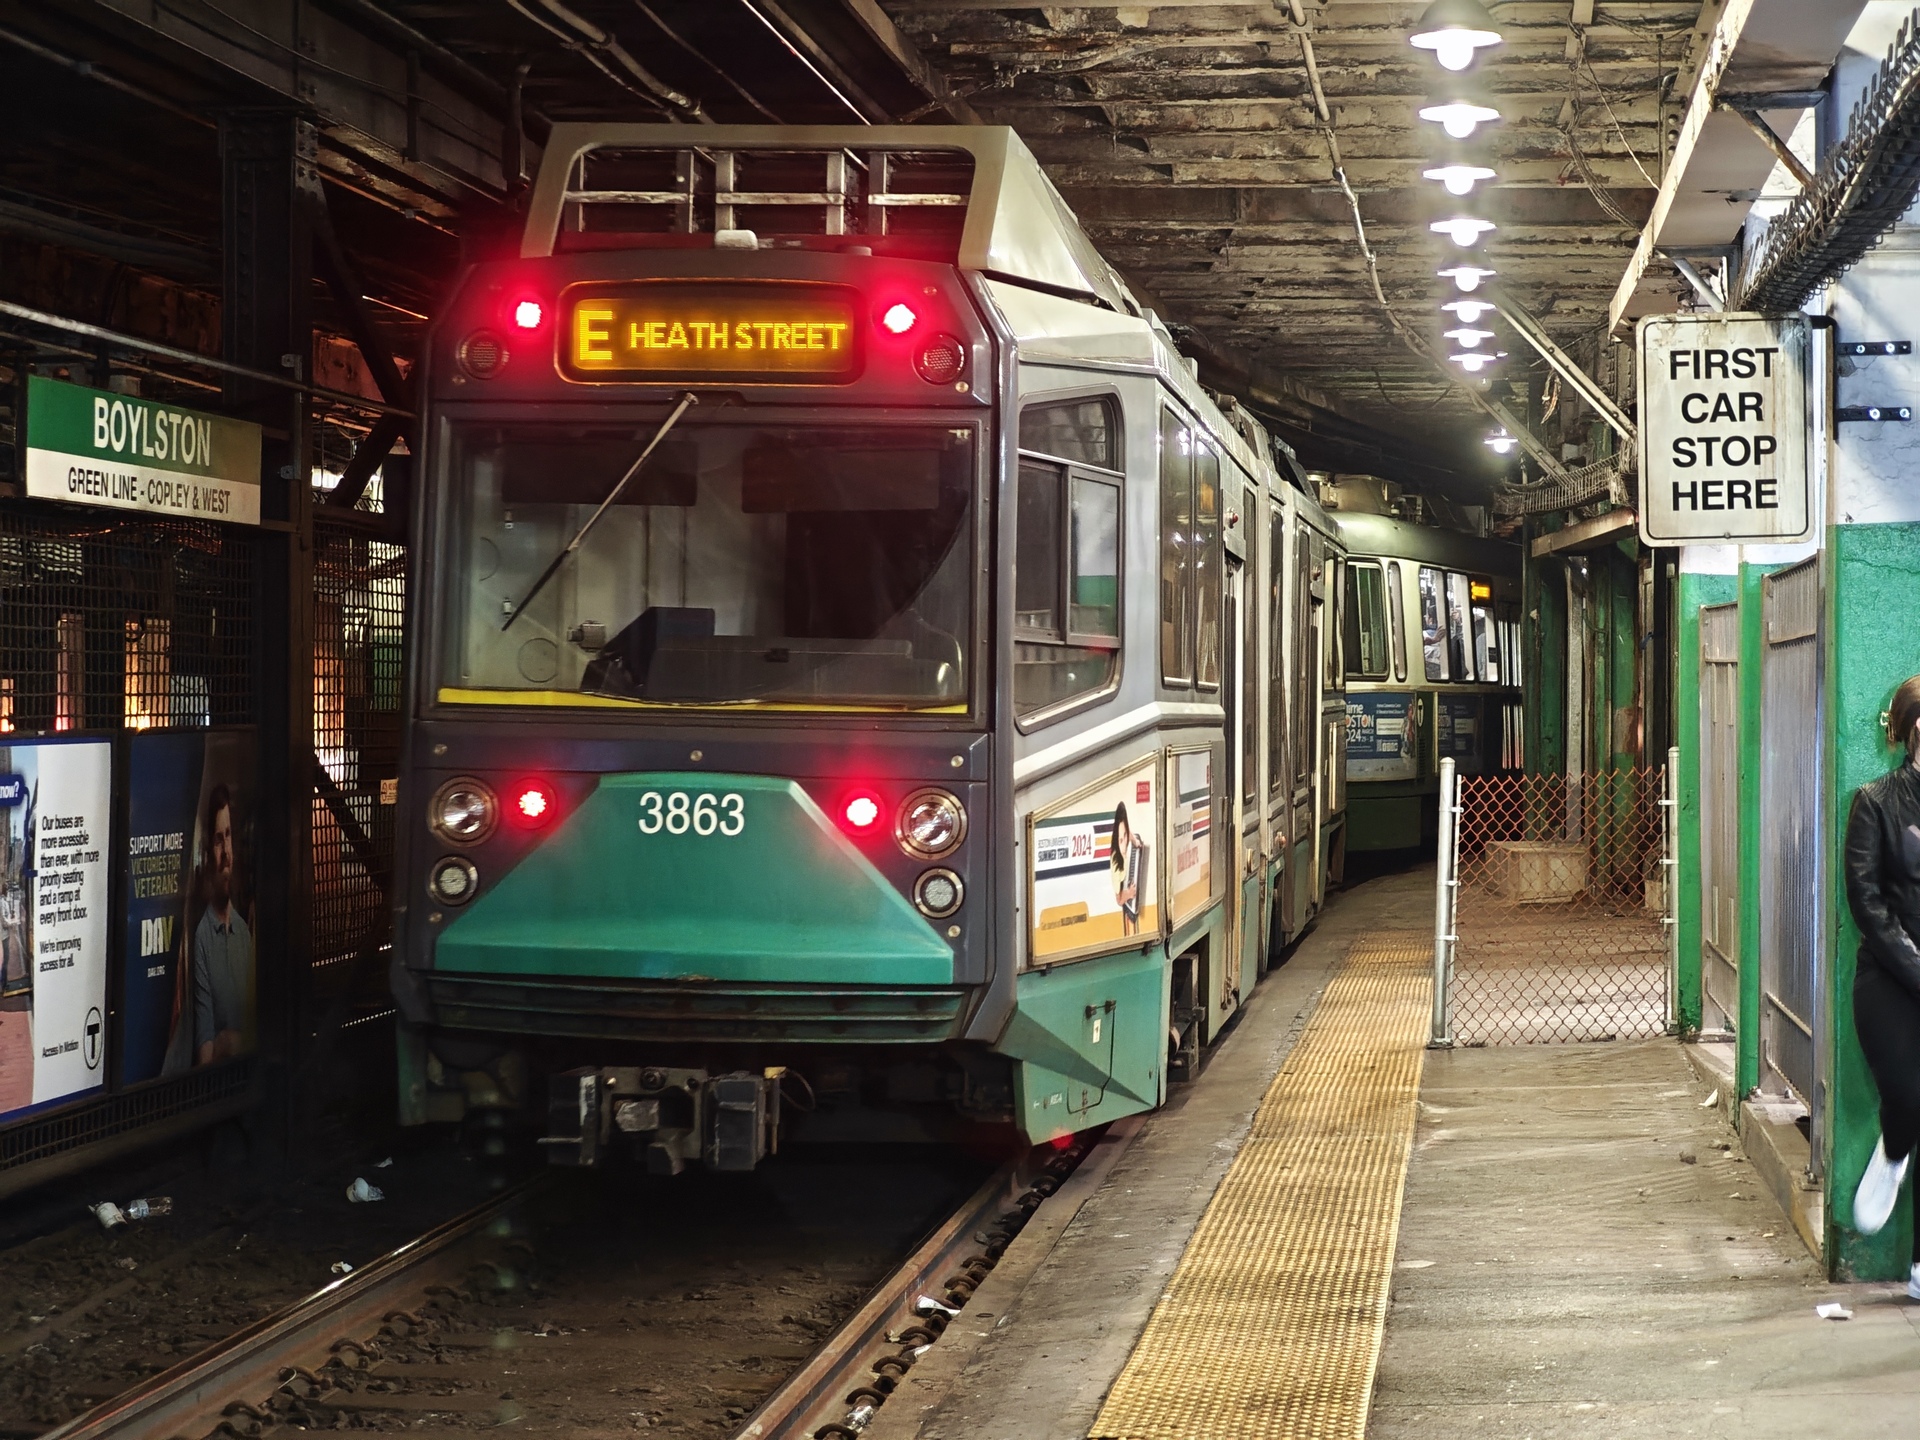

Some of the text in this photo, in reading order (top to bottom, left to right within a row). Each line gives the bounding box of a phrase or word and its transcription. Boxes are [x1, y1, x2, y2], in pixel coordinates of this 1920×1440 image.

[579, 310, 846, 360] E HEATH STREET
[1670, 347, 1779, 380] FIRST
[1681, 391, 1763, 423] CAR
[94, 396, 211, 467] BOYLSTON
[1672, 435, 1777, 468] STOP
[68, 466, 109, 498] GREEN
[112, 473, 137, 502] LINE
[147, 478, 189, 509] COPLEY
[192, 489, 200, 510] &
[202, 490, 231, 514] WEST
[1672, 478, 1779, 511] HERE
[1345, 714, 1375, 728] OSTON
[1346, 728, 1361, 742] 024
[0, 781, 20, 799] now?
[42, 814, 84, 831] Our buses are
[638, 791, 745, 836] 3863
[41, 830, 90, 850] more accessible
[129, 832, 184, 856] SUPPORT MORE
[1072, 834, 1092, 858] 2024
[40, 849, 100, 868] than ever, with more
[131, 853, 182, 876] VICTORIES FOR
[40, 867, 84, 892] priority seating
[134, 873, 179, 899] VETERANS
[40, 888, 81, 906] and a ramp at
[40, 906, 88, 927] every front door.
[39, 935, 82, 954] We're improving
[140, 915, 175, 957] DAV
[40, 959, 58, 972] access
[59, 956, 67, 969] for
[42, 1046, 58, 1058] Access
[64, 1040, 79, 1053] Motion
[87, 1023, 100, 1060] T
